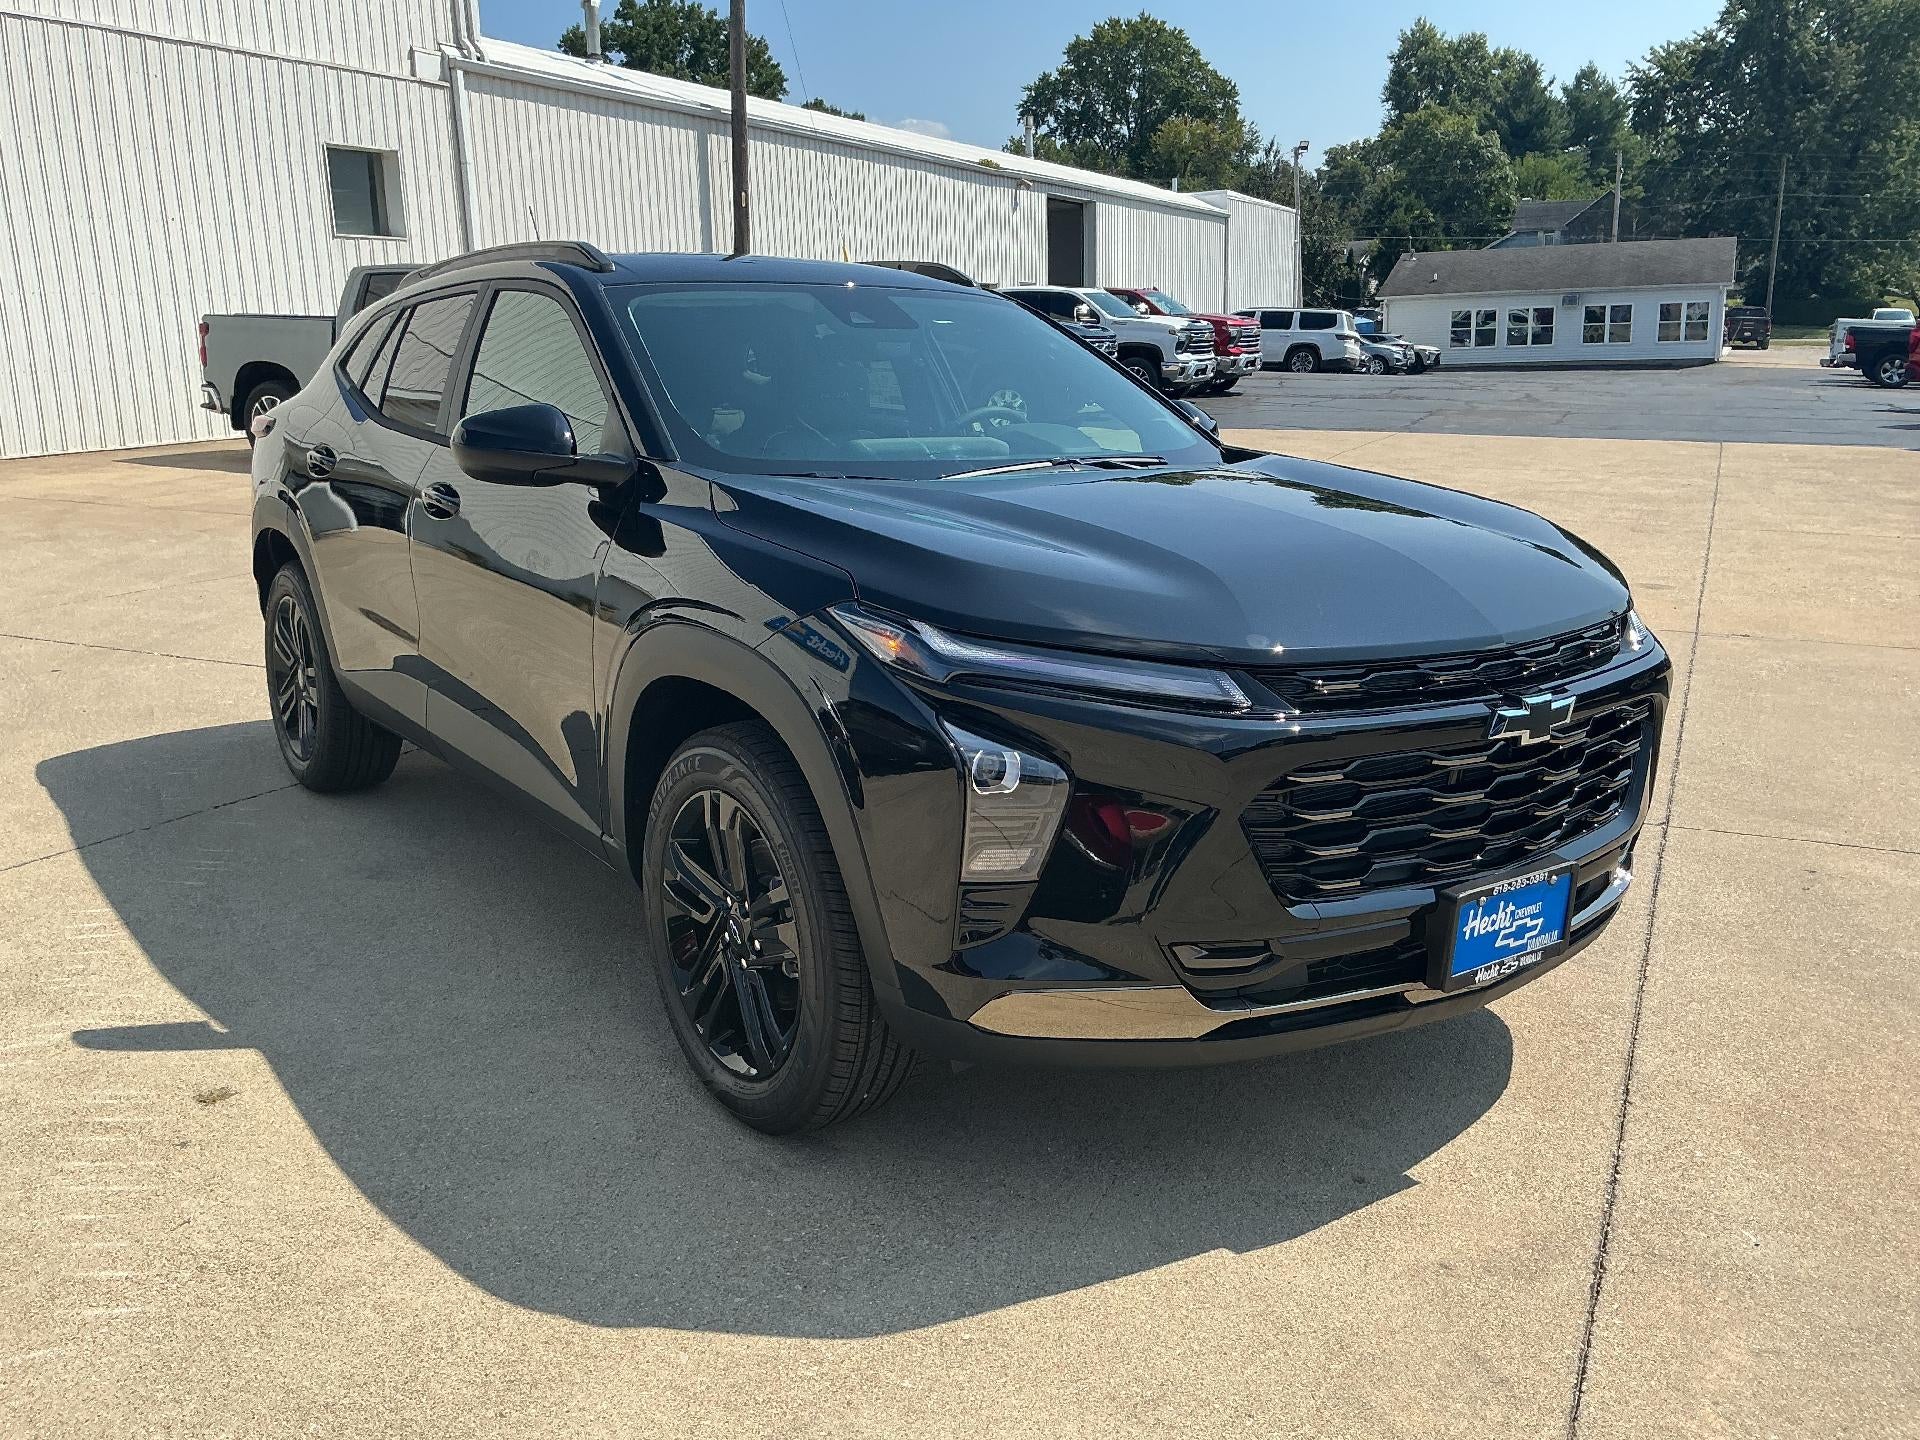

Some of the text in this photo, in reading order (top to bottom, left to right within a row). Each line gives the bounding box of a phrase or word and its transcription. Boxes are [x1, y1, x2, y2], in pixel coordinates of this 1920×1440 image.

[1462, 900, 1516, 941] Hecht
[1514, 901, 1543, 920] CHEVROLET
[1475, 964, 1500, 984] Hecht
